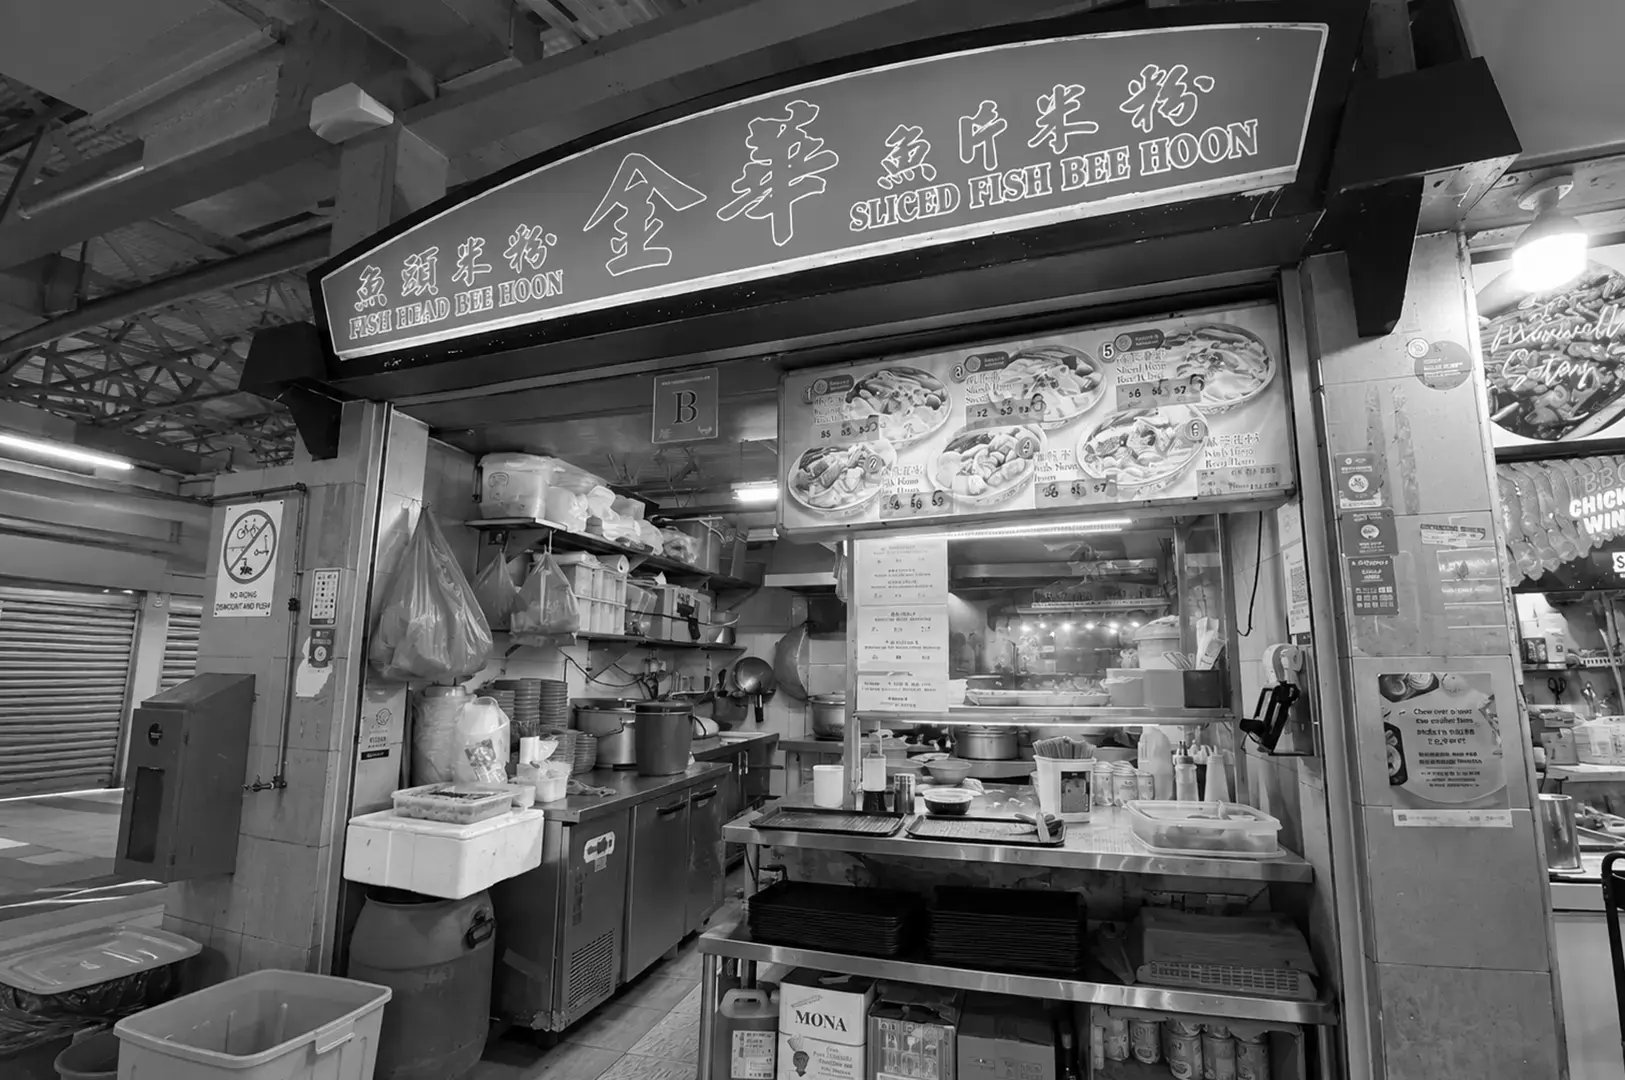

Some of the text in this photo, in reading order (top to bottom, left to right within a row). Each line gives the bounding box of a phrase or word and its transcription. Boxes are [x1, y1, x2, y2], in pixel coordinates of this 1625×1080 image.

[849, 118, 1259, 231] SLICED FISH BEE HOON
[349, 269, 563, 340] FISH HEAD BEE HOON
[672, 389, 699, 425] B
[230, 591, 238, 599] NO
[796, 1010, 847, 1032] MONA
